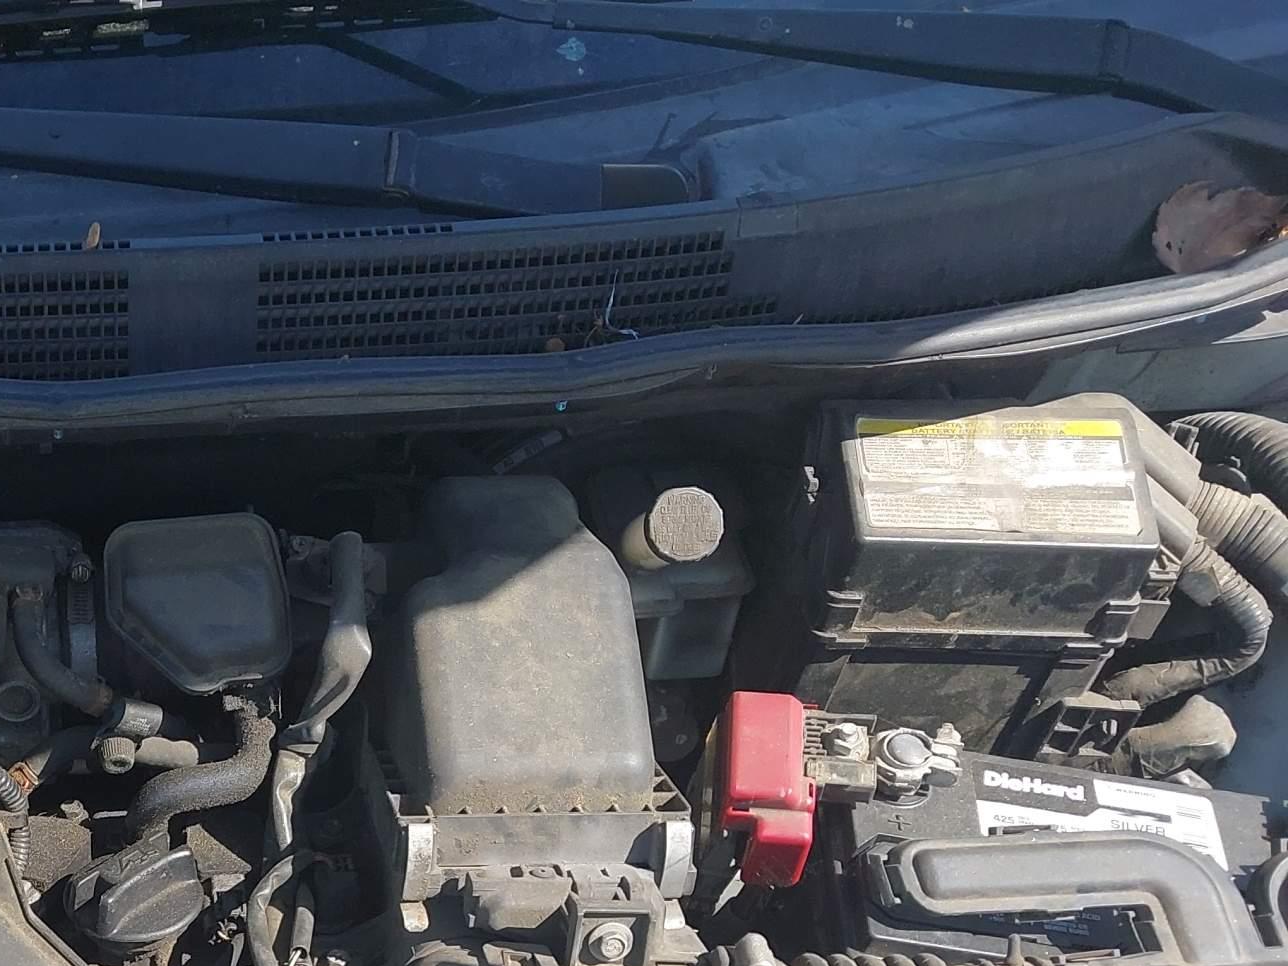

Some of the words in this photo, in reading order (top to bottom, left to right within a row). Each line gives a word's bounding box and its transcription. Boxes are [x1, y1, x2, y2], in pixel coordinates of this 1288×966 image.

[983, 770, 1086, 801] DieHard
[993, 814, 1015, 825] 425
[1111, 819, 1167, 838] SILVER
